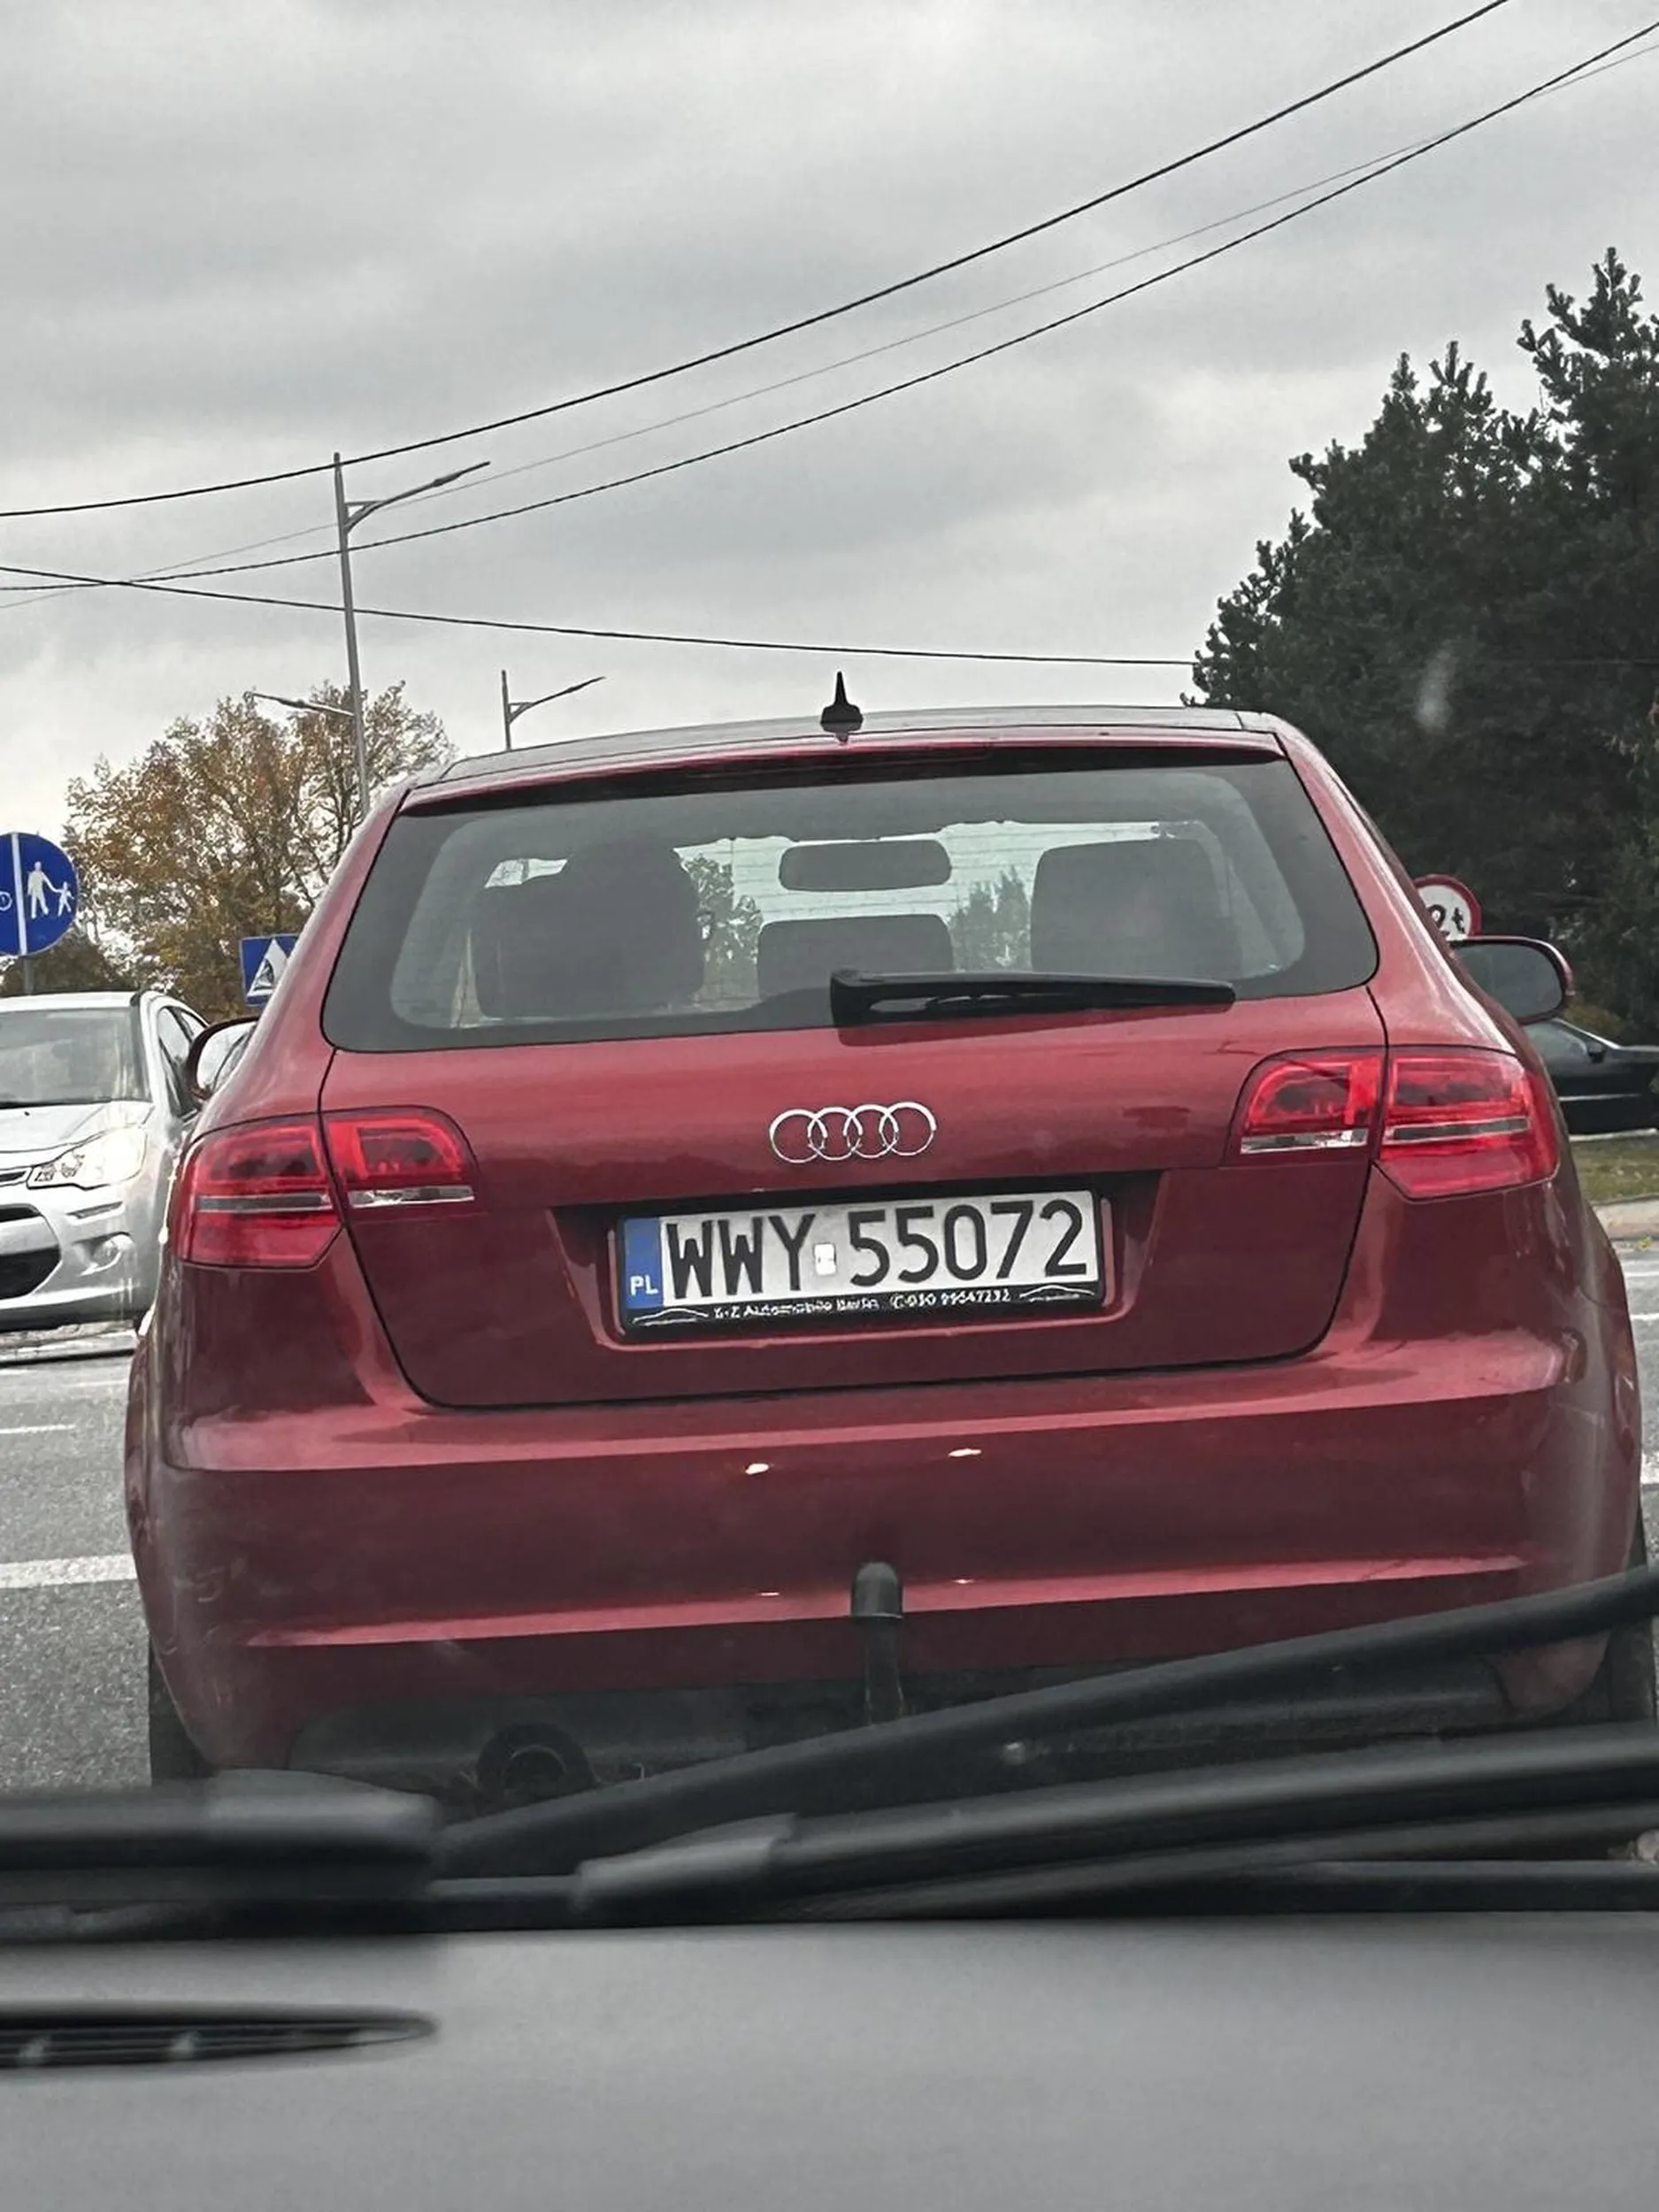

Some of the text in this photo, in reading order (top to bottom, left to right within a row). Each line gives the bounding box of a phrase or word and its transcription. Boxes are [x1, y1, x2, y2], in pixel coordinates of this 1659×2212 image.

[666, 1199, 1087, 1300] WWY 55072
[629, 1275, 658, 1297] PL
